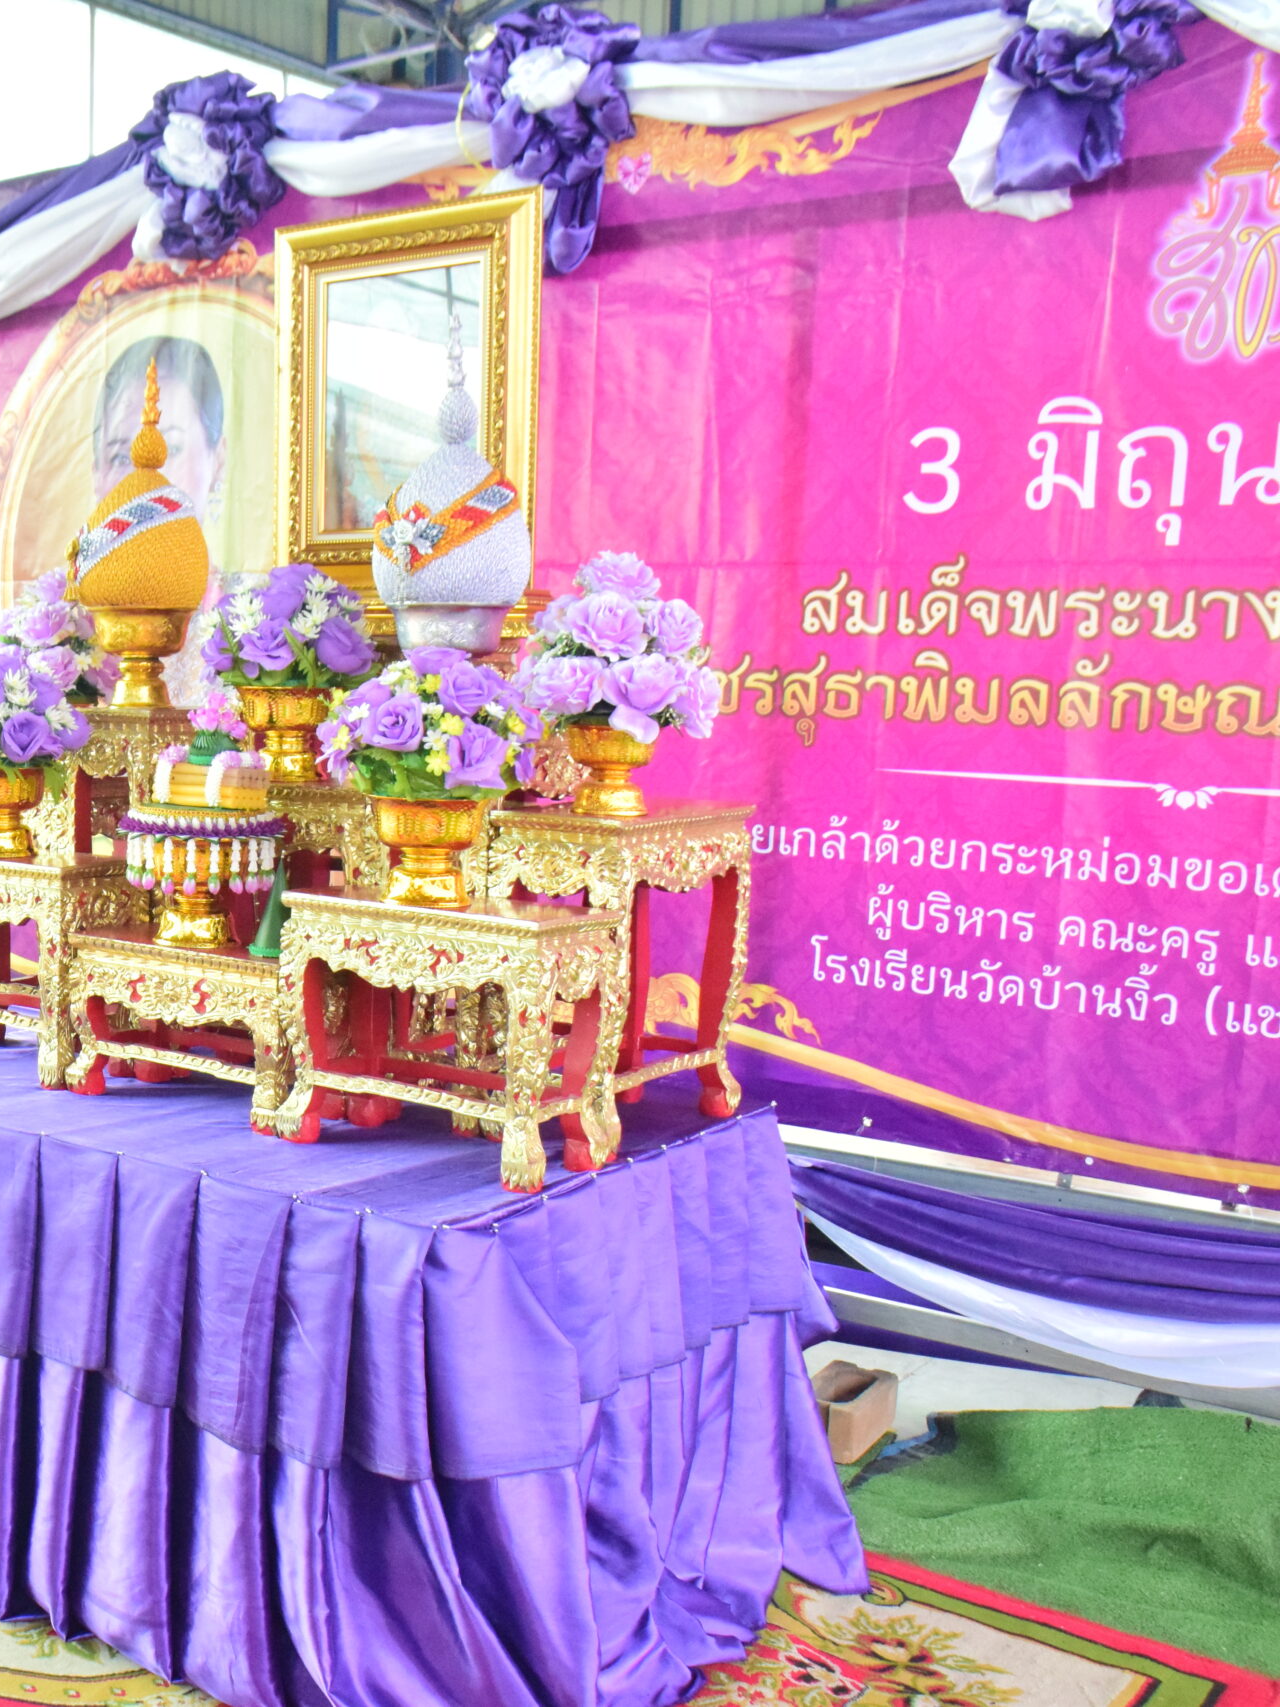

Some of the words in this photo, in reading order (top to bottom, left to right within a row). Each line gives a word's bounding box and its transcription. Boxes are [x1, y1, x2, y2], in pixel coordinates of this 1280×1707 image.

[903, 427, 962, 514] 3
[801, 553, 1280, 640] สมเด็จพระนาง
[867, 883, 1036, 941] ผู้บริหาร
[1058, 915, 1220, 976] คณะครู
[810, 935, 1178, 1026] โรงเรียนวัดบ้านงิ้ว
